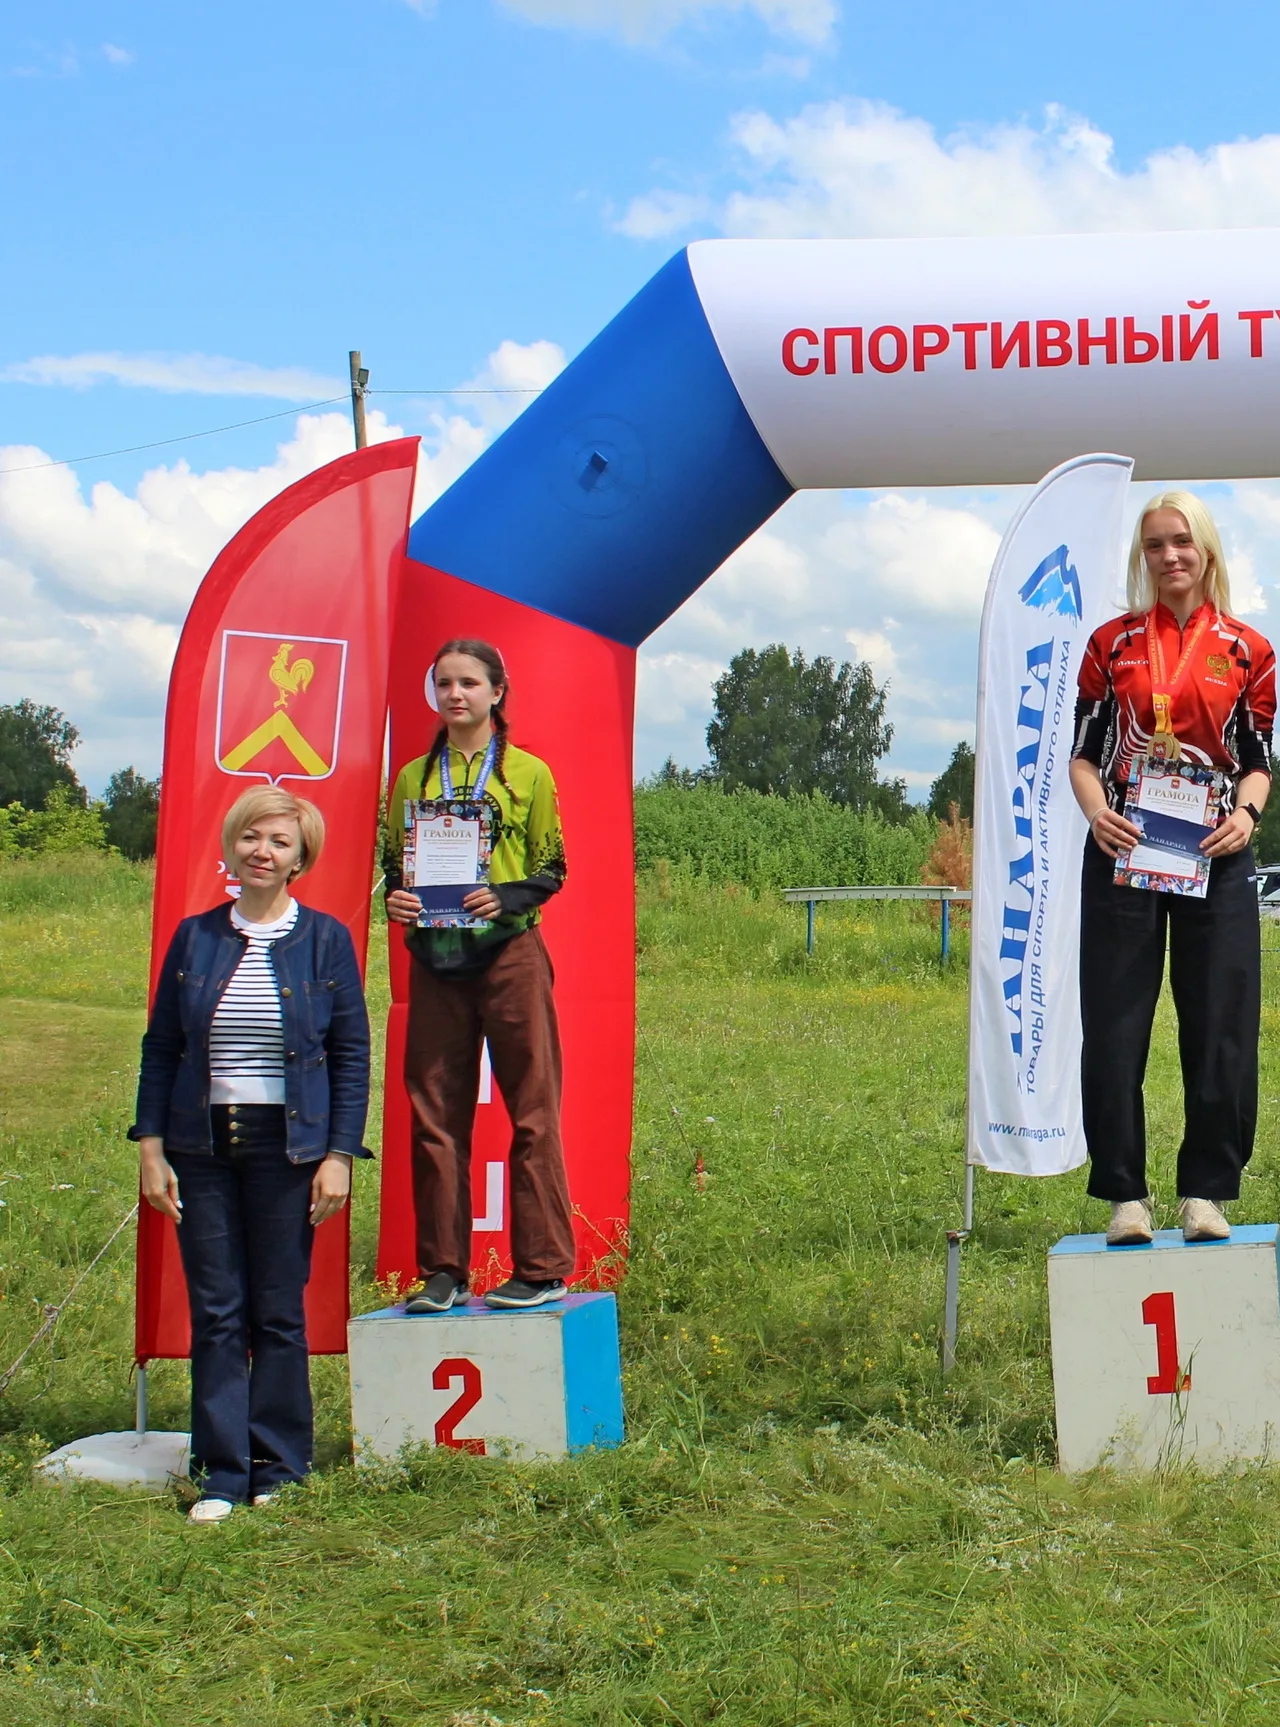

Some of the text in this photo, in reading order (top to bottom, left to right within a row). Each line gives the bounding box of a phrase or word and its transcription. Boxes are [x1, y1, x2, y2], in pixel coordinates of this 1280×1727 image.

[780, 299, 1219, 376] СПОРТИВНЫЙ
[423, 829, 472, 838] ГРАМОТА
[1147, 787, 1200, 804] ГРАМОТА
[1027, 641, 1070, 1094] ТОВАРЫ ДЛЯ СПОРТА И АКТИВНОГО ОТДЫХА
[1149, 836, 1187, 850] МАНАРАГА
[1142, 1292, 1192, 1394] 1
[432, 1358, 487, 1455] 2
